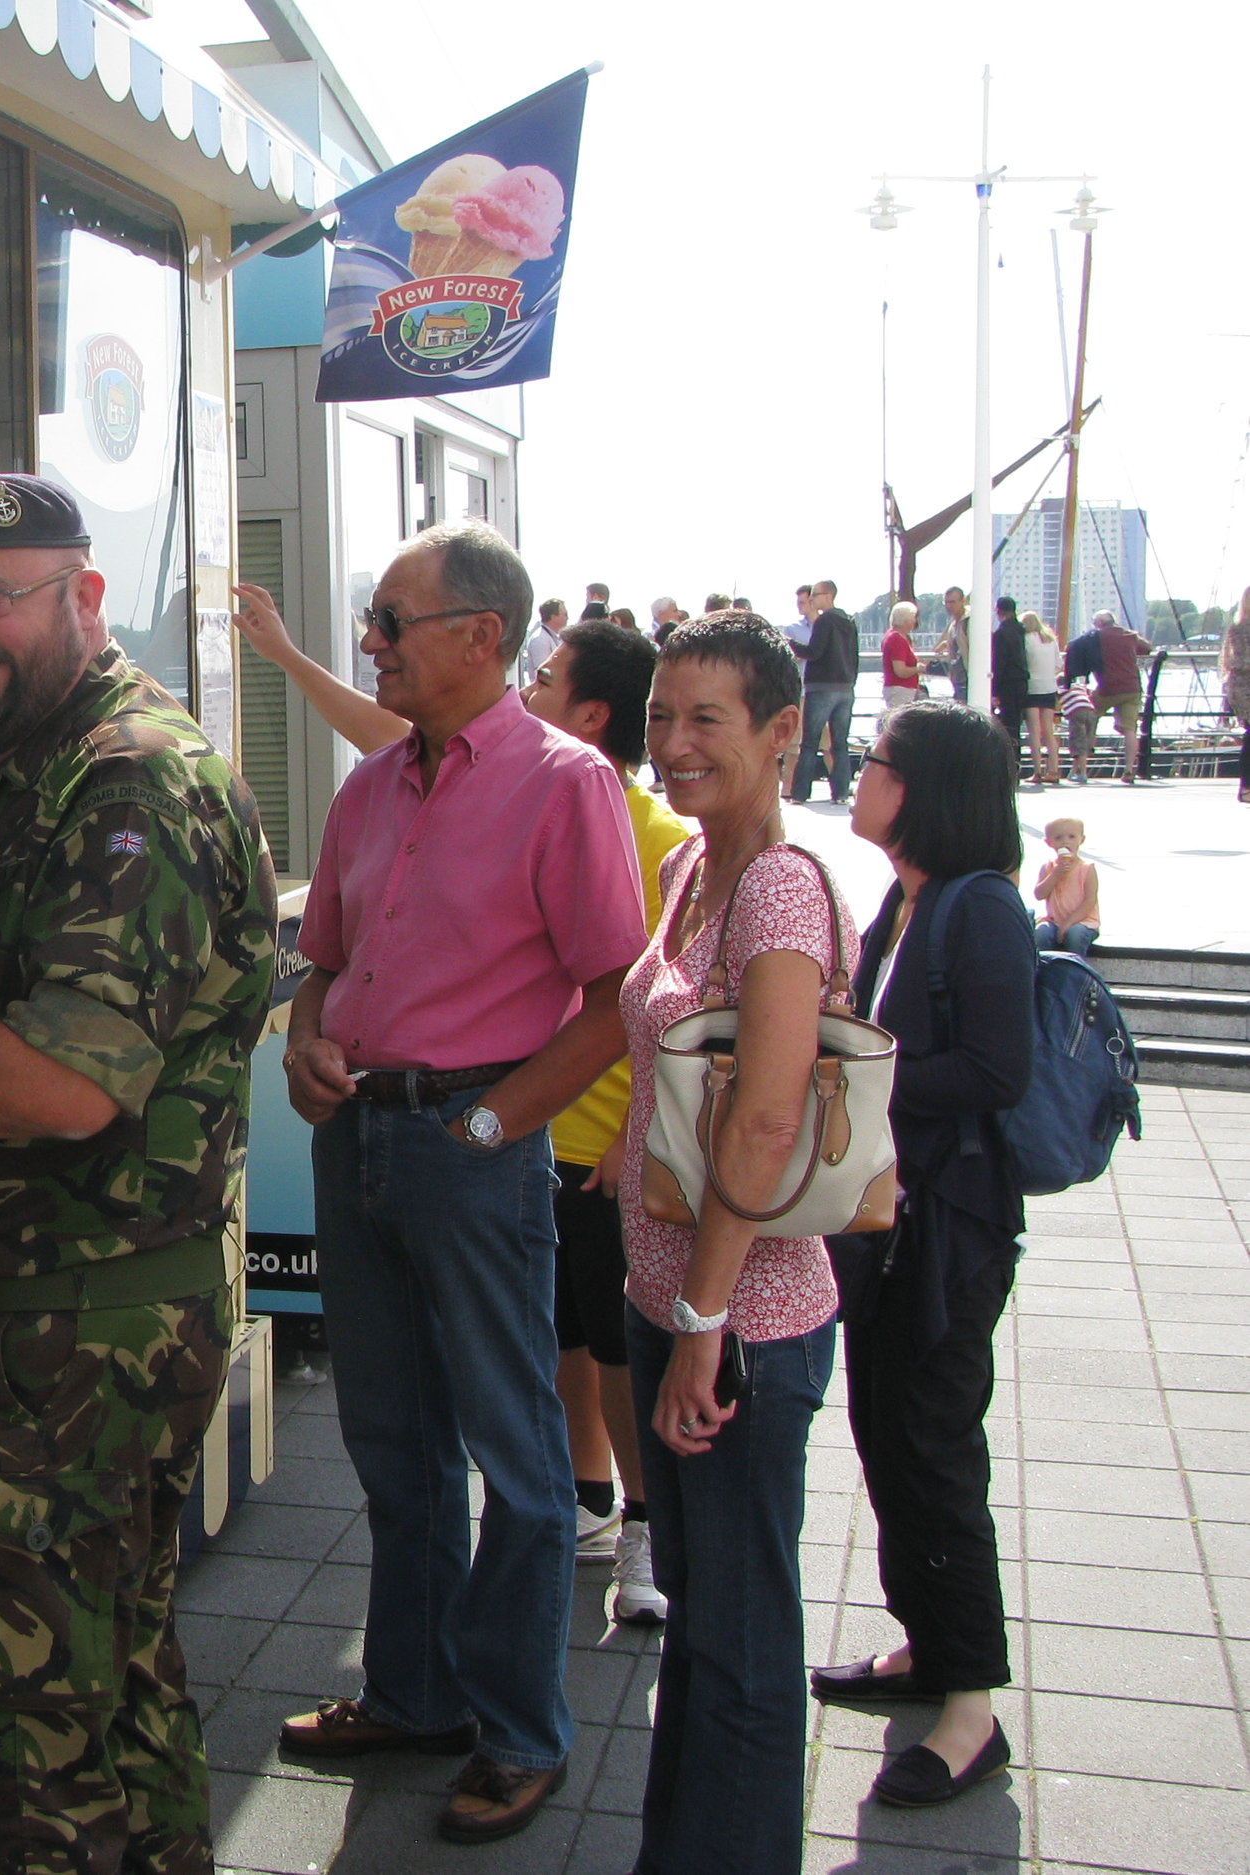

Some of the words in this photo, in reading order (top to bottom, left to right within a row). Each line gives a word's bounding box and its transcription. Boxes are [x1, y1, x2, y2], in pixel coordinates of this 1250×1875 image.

[387, 285, 435, 312] New
[443, 280, 509, 302] Forest
[92, 345, 111, 370] New
[113, 341, 140, 383] Forest
[392, 342, 419, 367] ICE
[429, 335, 494, 371] CREAM
[80, 788, 116, 810] BOMB
